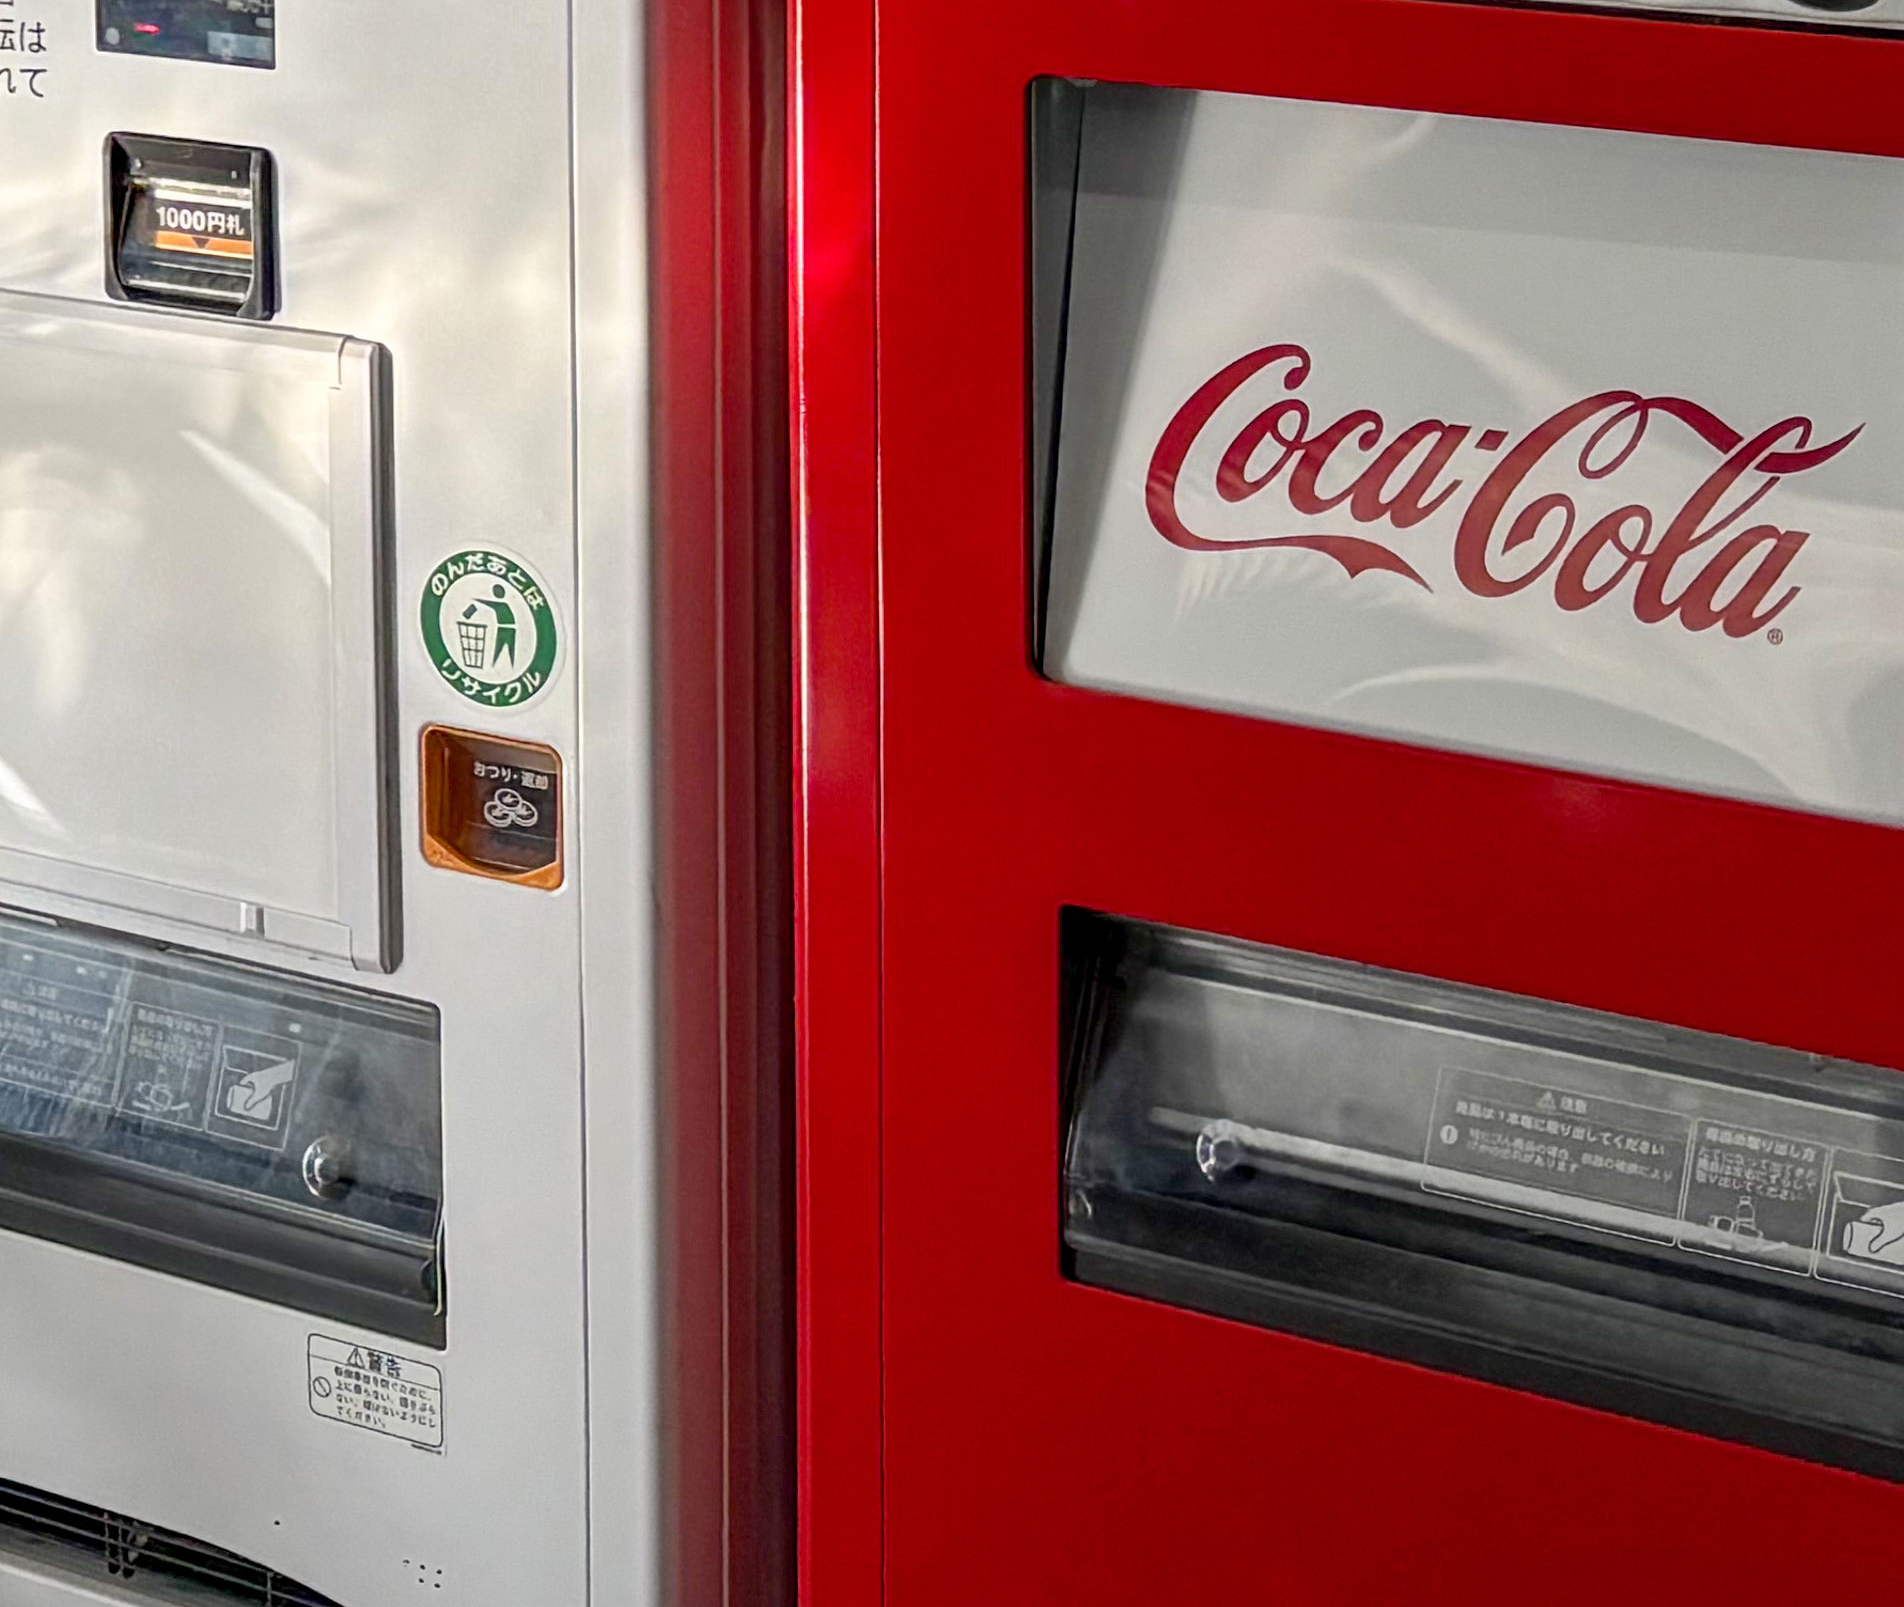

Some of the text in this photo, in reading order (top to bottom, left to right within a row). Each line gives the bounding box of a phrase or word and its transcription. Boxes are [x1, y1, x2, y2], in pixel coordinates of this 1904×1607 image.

[156, 205, 245, 236] 1000円札
[1144, 343, 1867, 639] Coca-Cola
[431, 551, 545, 611] のんだあとは
[442, 657, 542, 706] リサイクル
